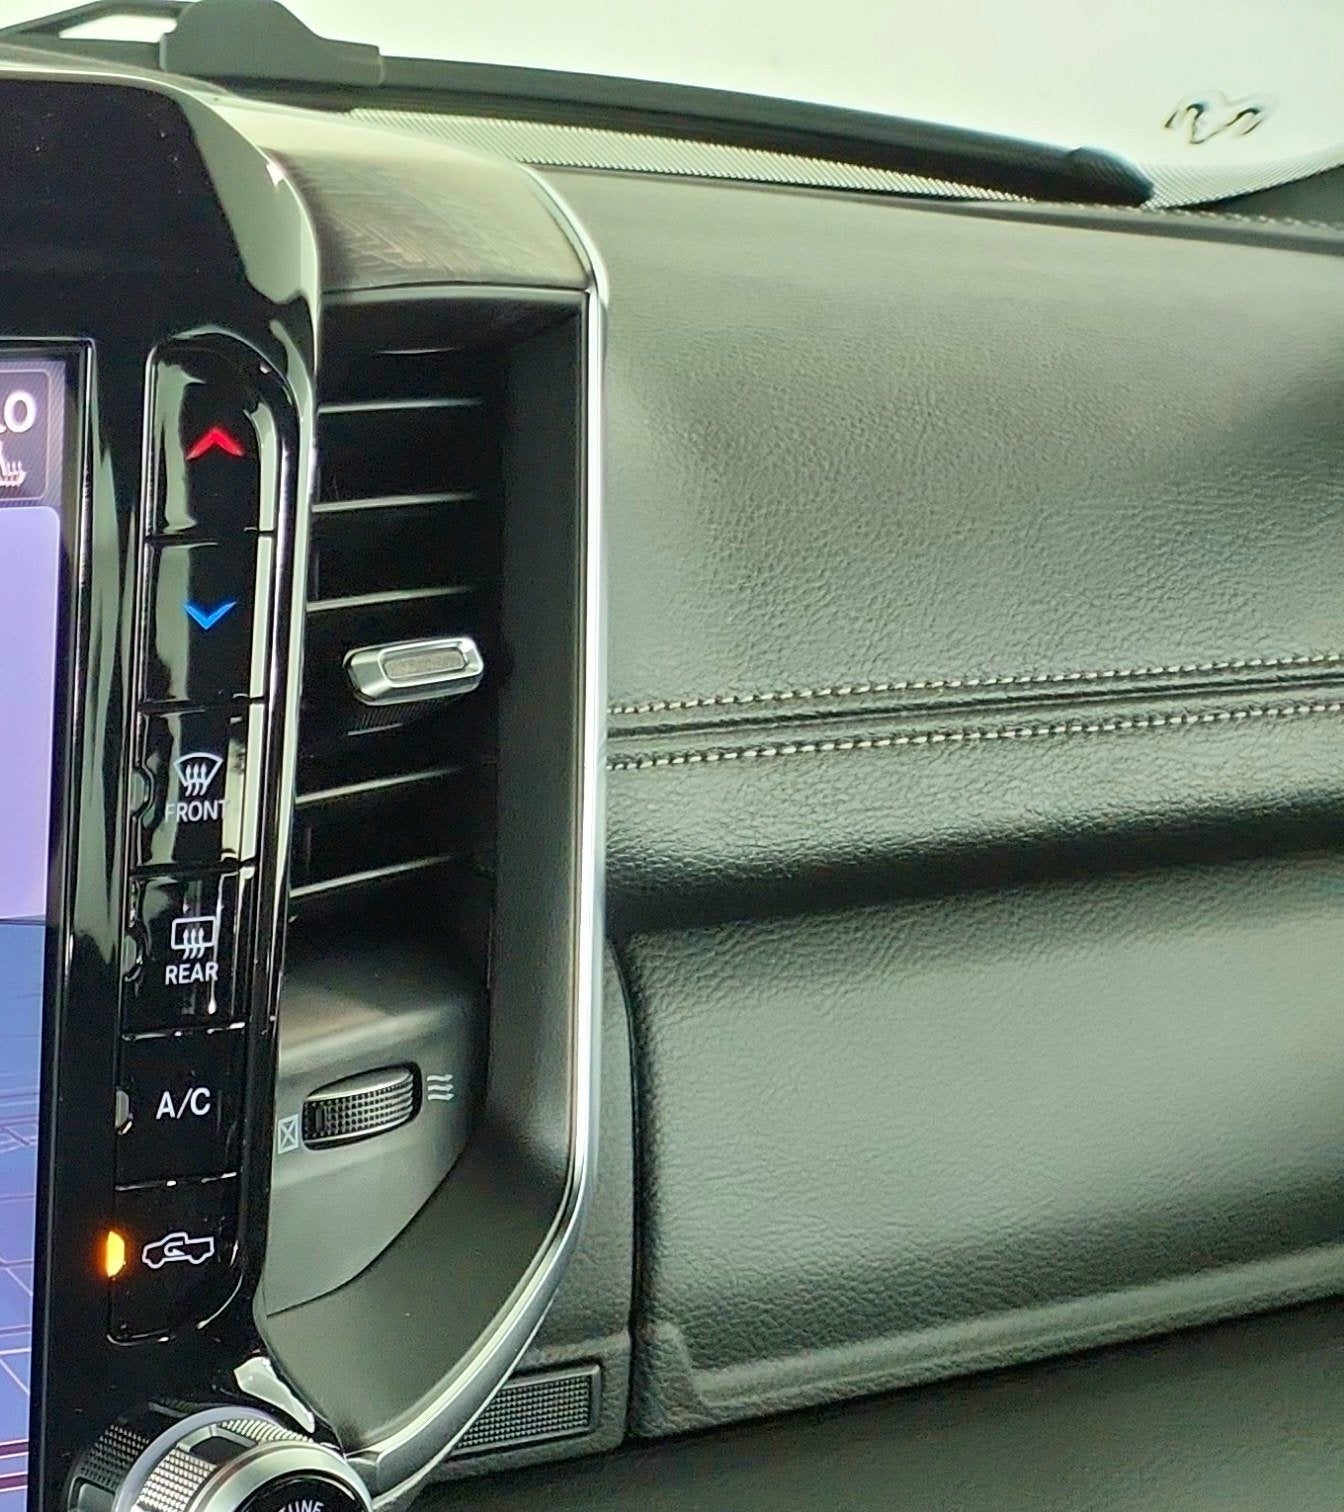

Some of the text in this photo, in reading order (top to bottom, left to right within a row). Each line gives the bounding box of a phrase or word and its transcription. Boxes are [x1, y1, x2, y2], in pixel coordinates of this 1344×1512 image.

[164, 798, 229, 822] FRONT
[164, 963, 219, 984] REAR
[156, 1086, 211, 1119] A/C
